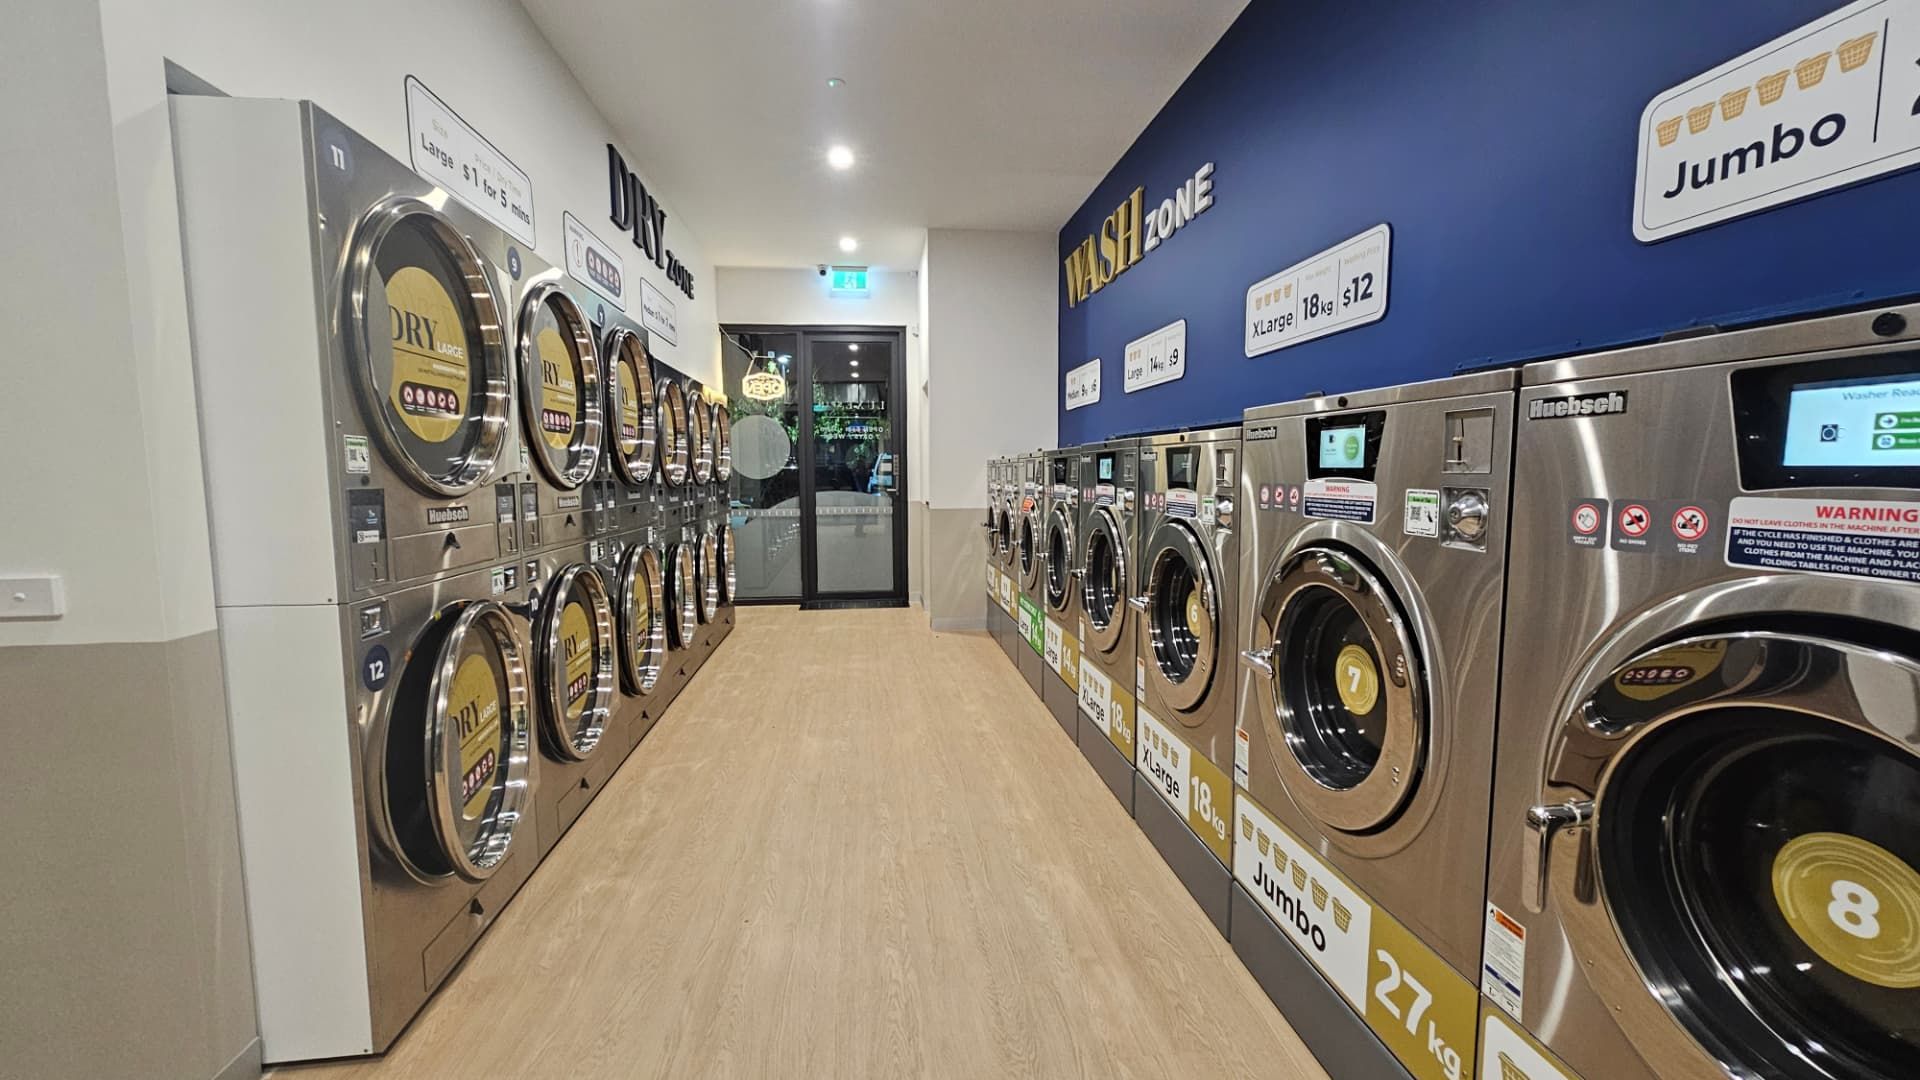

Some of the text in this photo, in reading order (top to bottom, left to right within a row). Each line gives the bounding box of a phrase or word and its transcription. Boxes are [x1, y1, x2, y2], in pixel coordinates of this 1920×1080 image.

[330, 144, 346, 170] 11
[1663, 113, 1846, 199] Jumbo
[421, 132, 530, 225] Large $1 for 5 mins
[606, 143, 694, 300] DRY ZONE
[1064, 162, 1214, 309] WASH ZONE
[511, 260, 518, 272] 9
[1252, 312, 1294, 338] XLarge
[1342, 272, 1374, 308] $12
[437, 340, 464, 359] LARGE
[541, 359, 560, 386] RY
[1128, 366, 1143, 380] Large
[1169, 348, 1179, 367] $9
[1529, 391, 1624, 420] Huebsch
[1842, 390, 1888, 400] Washer
[429, 506, 469, 524] Huebsch
[1760, 519, 1781, 527] LEAVE
[1784, 520, 1818, 528] CLOTHES
[1847, 524, 1889, 532] MACHINE
[1816, 505, 1919, 523] WARNING
[1741, 529, 1756, 537] THE
[1757, 531, 1782, 539] CYCLE
[1801, 534, 1843, 543] FINISHED
[1853, 537, 1896, 547] CLOTHES
[1898, 540, 1919, 548] ARE
[1756, 539, 1772, 547] YOU
[1773, 540, 1795, 549] NEED
[1796, 542, 1808, 550] TO
[1828, 544, 1846, 553] THE
[1897, 550, 1919, 559] YOU
[1744, 547, 1779, 556] CLOTHES
[1780, 550, 1805, 558] FROM
[1824, 554, 1867, 564] MACHINE
[1869, 558, 1891, 567] AND
[1761, 557, 1797, 567] FOLDING
[1799, 561, 1830, 571] TABLES
[1831, 564, 1850, 572] FOR
[1851, 566, 1870, 574] THE
[1871, 568, 1909, 578] OWNER
[530, 599, 539, 612] 10
[1190, 606, 1198, 622] 6
[564, 631, 578, 660] RY
[369, 660, 385, 681] 12
[1348, 665, 1361, 693] 7
[1082, 685, 1105, 722] XLarge
[1143, 743, 1180, 798] XLarge
[1253, 861, 1327, 953] Jumbo
[1828, 879, 1880, 939] 8
